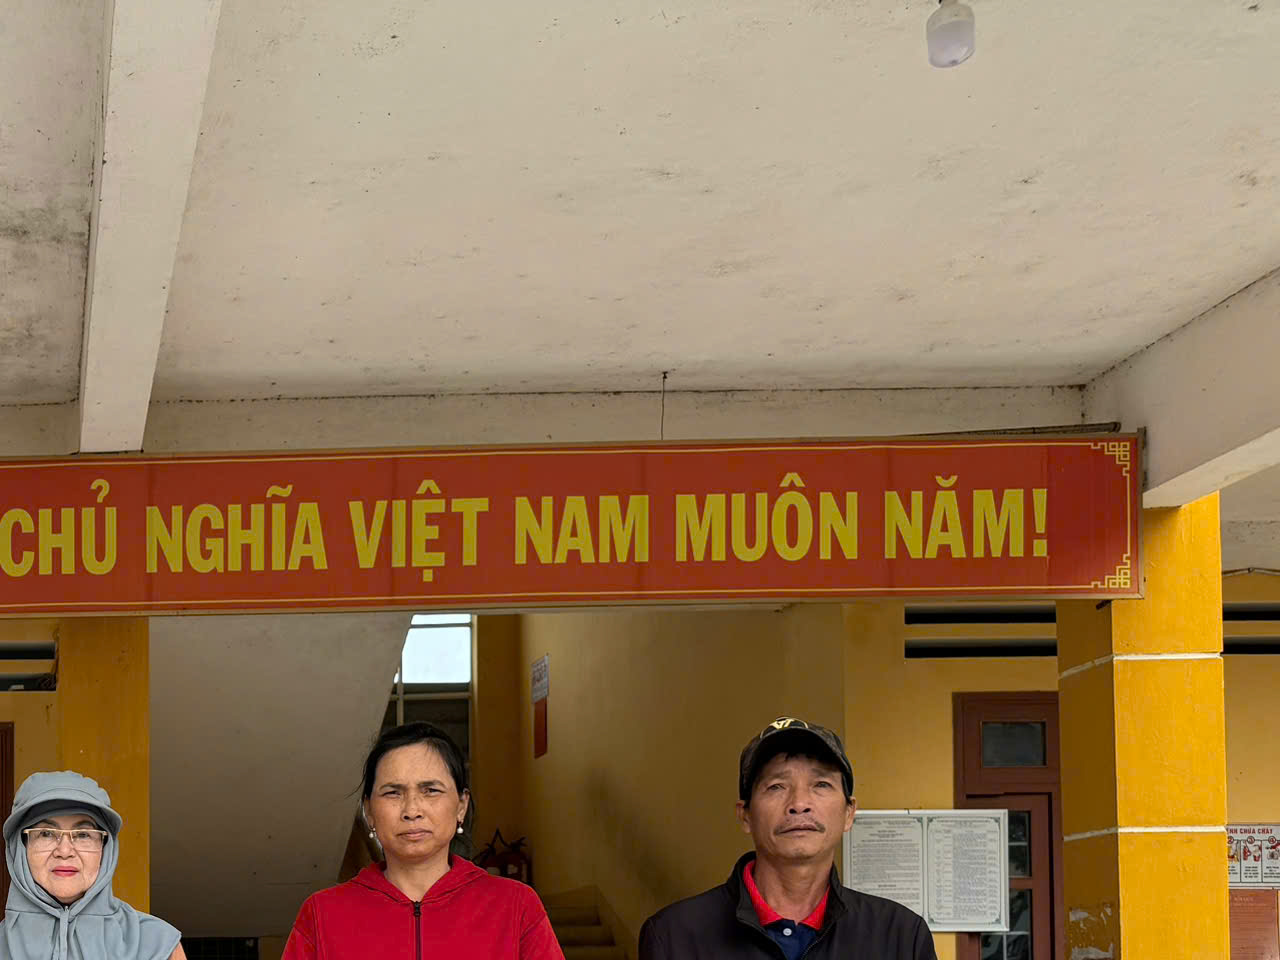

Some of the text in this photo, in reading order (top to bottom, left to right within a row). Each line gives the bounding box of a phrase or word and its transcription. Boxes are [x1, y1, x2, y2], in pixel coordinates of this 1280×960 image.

[145, 483, 329, 574] NGHĨA
[348, 479, 490, 582] VIỆT
[514, 494, 650, 565] NAM
[674, 472, 858, 563] MUÔN
[884, 474, 1048, 560] NĂM!
